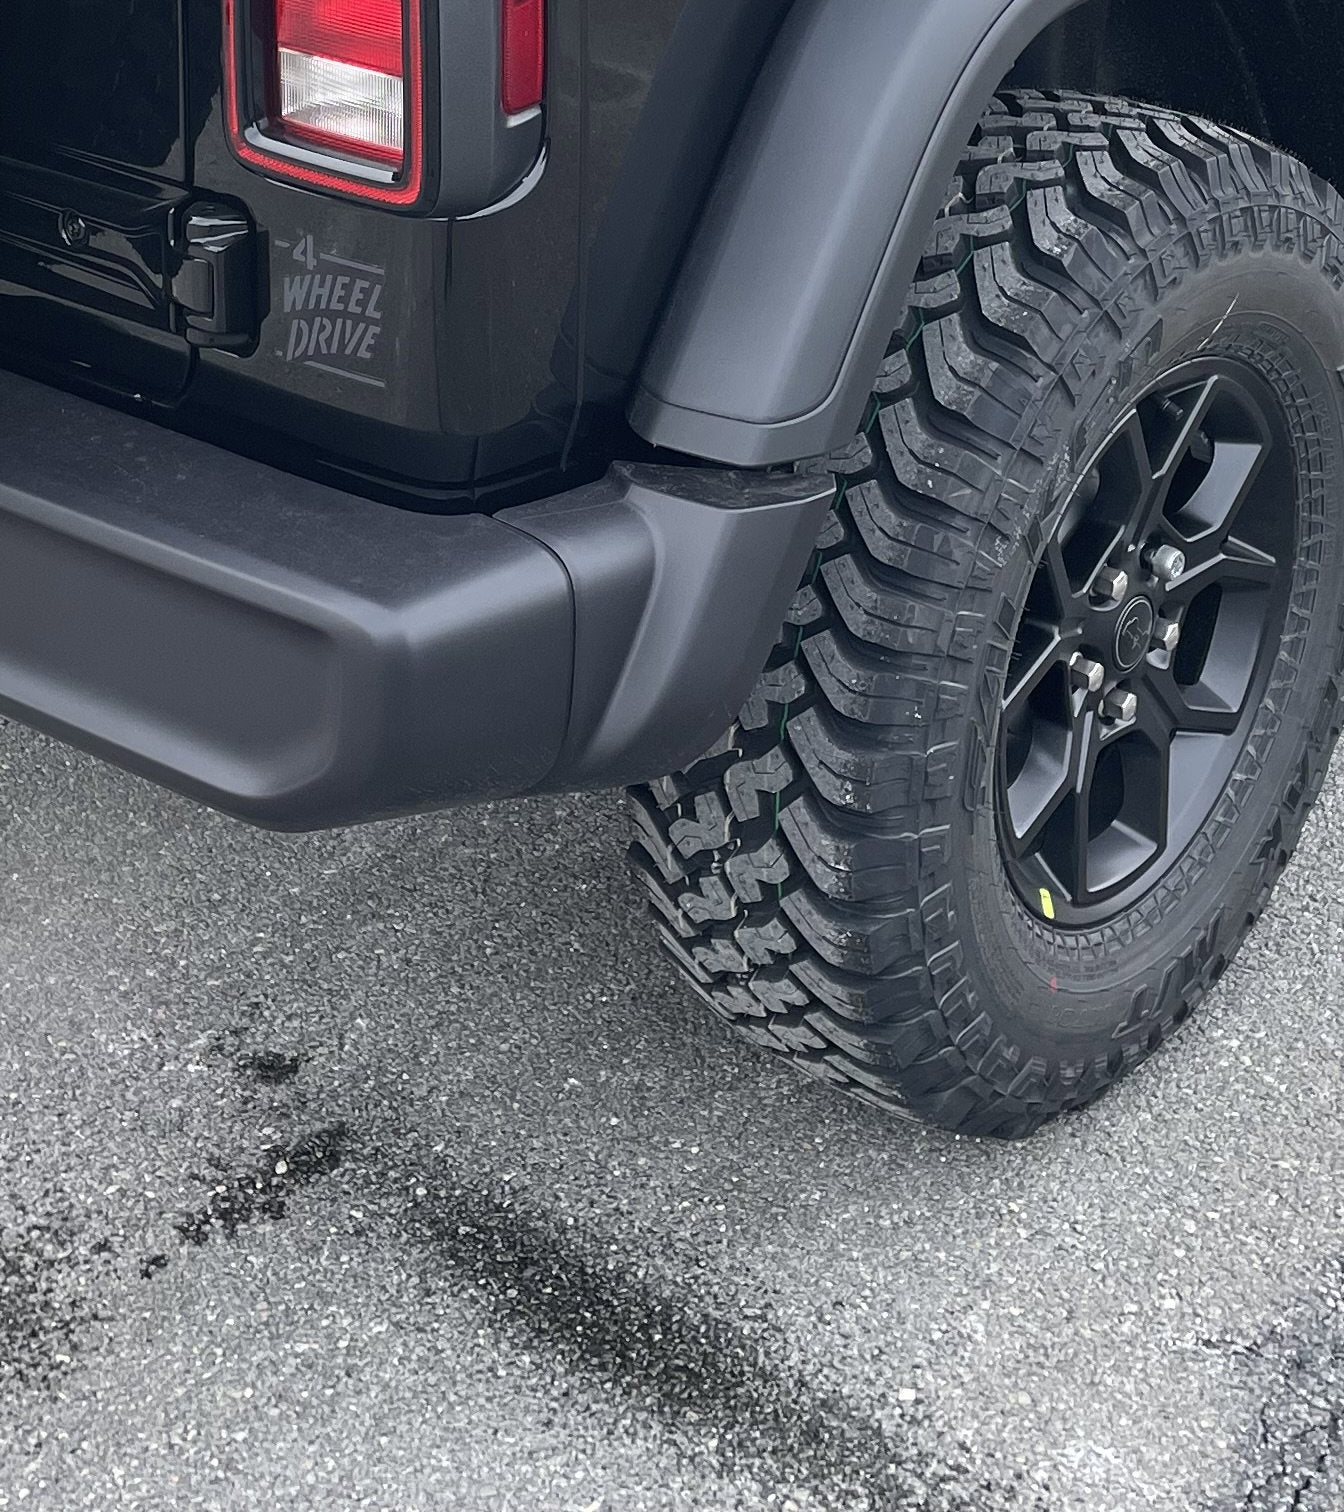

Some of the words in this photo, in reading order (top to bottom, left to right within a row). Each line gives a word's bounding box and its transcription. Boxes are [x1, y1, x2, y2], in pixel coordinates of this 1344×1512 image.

[292, 234, 318, 270] 4
[283, 273, 384, 320] WHEEL
[286, 316, 382, 362] DRIVE
